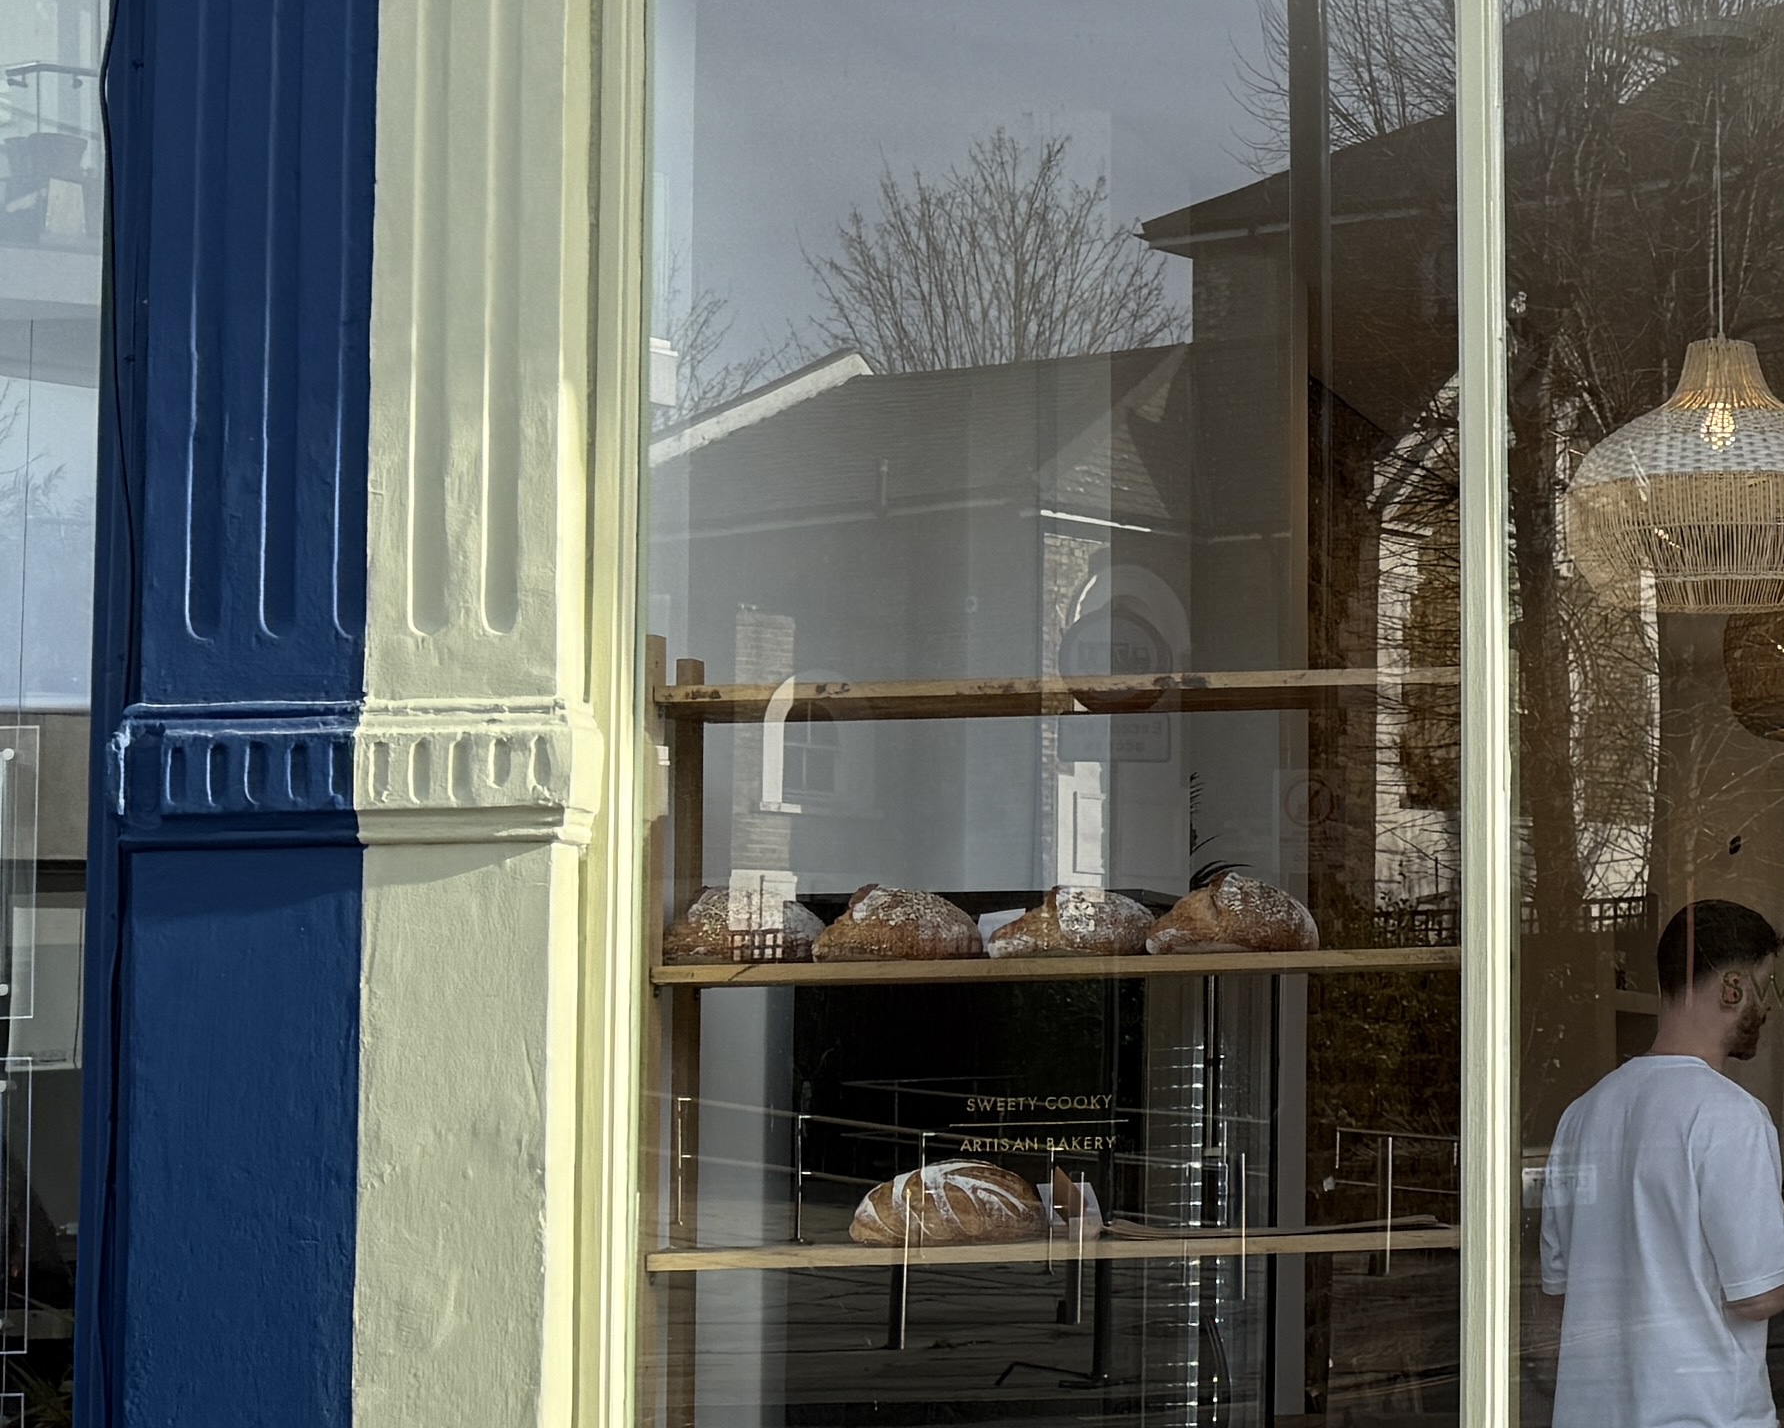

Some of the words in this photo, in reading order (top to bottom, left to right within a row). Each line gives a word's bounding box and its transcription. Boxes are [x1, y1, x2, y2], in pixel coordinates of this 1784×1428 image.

[966, 1096, 1038, 1112] SWEETY
[1044, 1094, 1113, 1110] COOKY
[959, 1137, 1038, 1153] ARTISAN
[1046, 1135, 1117, 1151] BAKERY
